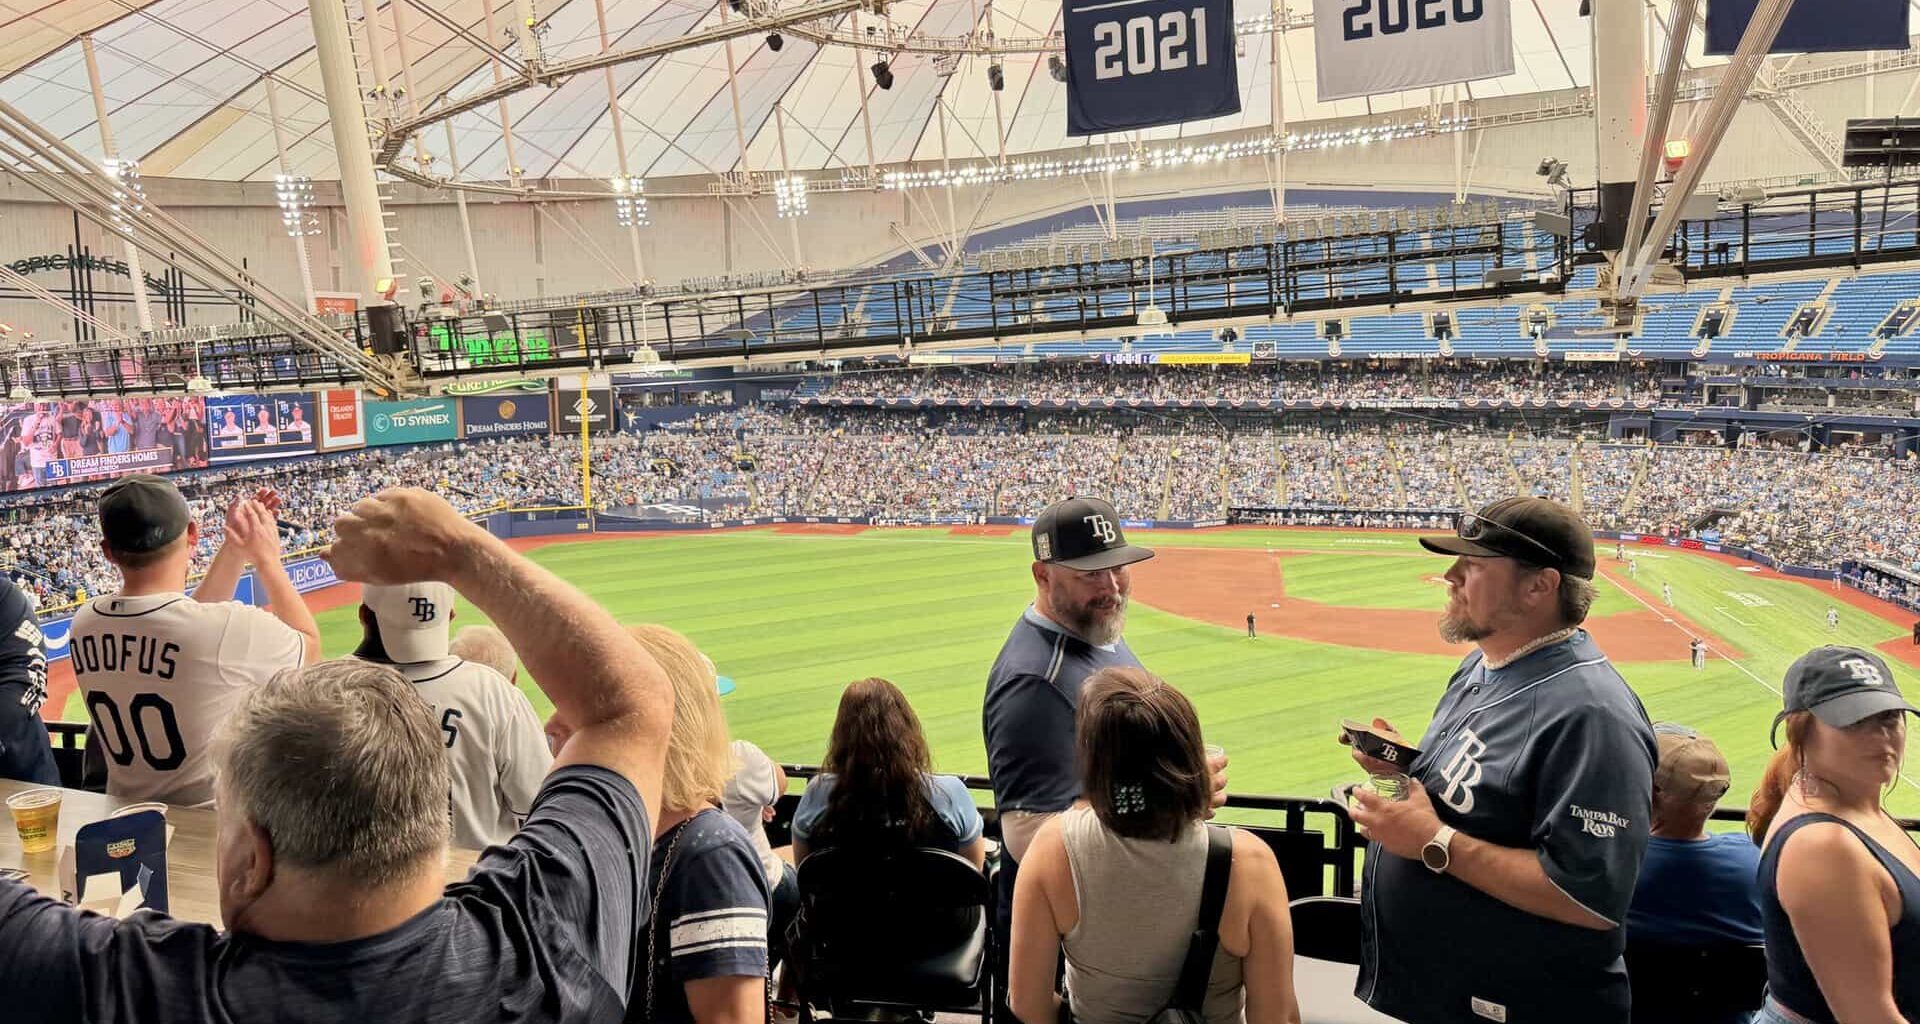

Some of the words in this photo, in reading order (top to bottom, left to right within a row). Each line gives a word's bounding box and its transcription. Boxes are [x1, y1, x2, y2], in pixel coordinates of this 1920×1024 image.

[1095, 8, 1208, 80] 2021
[1755, 352, 1823, 360] TROPICANA
[1830, 352, 1865, 361] FIELD
[1413, 401, 1438, 409] Group
[391, 415, 404, 427] TD
[408, 413, 450, 426] SYNNEX
[466, 422, 493, 435] DREAM
[494, 421, 522, 433] FINDERS
[523, 420, 548, 431] HOMES
[49, 461, 64, 477] TB
[71, 457, 98, 470] DREAM
[100, 453, 131, 466] FINDERS
[132, 450, 158, 462] HOMES
[1083, 514, 1116, 544] TB
[408, 597, 436, 622] TB
[70, 633, 180, 680] DOOFUS
[1839, 659, 1884, 685] TB
[86, 690, 187, 771] 00
[1381, 743, 1398, 762] TB
[1439, 728, 1487, 814] TB
[1570, 804, 1608, 821] TAMPA
[1608, 811, 1630, 829] BAY
[1581, 818, 1616, 837] RAYS
